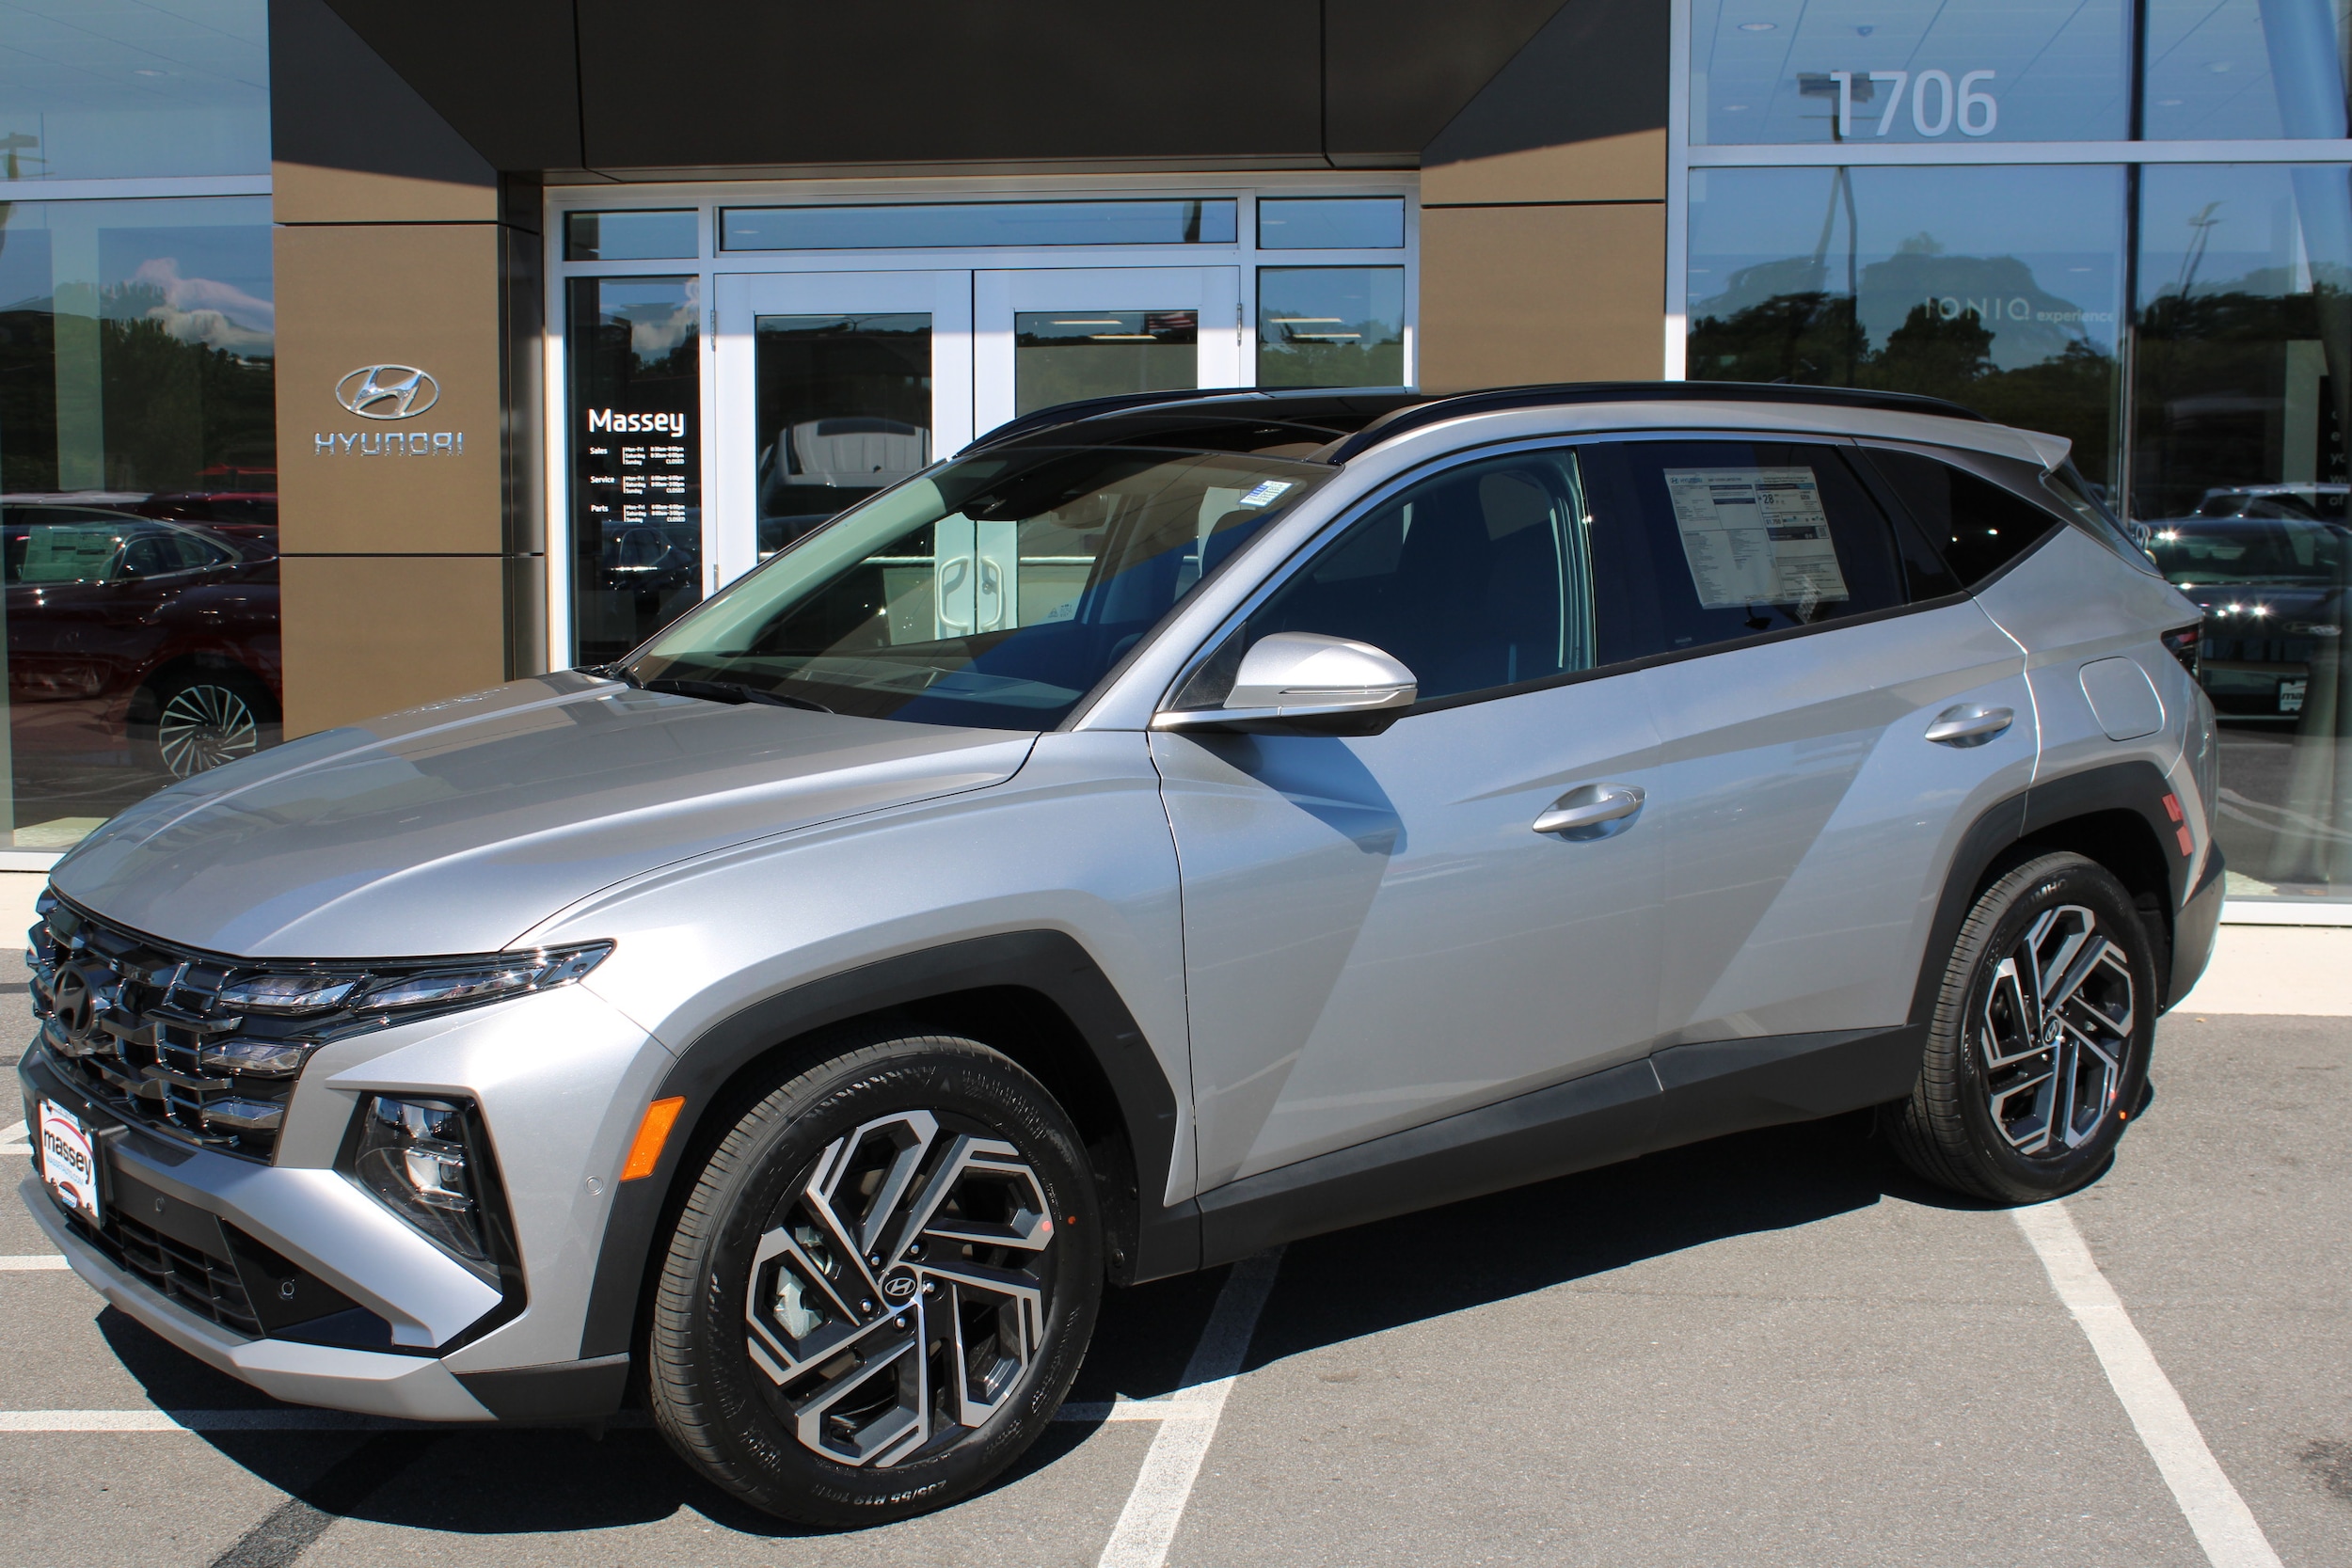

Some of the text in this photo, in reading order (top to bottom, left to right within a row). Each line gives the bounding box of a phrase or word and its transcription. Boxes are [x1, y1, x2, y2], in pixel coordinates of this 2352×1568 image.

[1830, 70, 1997, 137] 1706
[1926, 296, 2114, 324] IONIQ experience
[588, 408, 686, 437] Massey
[314, 432, 464, 457] HYUNDAI
[589, 447, 609, 455] Sales
[590, 504, 609, 513] Parts
[1762, 494, 1774, 505] 28
[43, 1129, 92, 1185] massey
[853, 1494, 887, 1506] R19
[890, 1480, 947, 1504] 235/55
